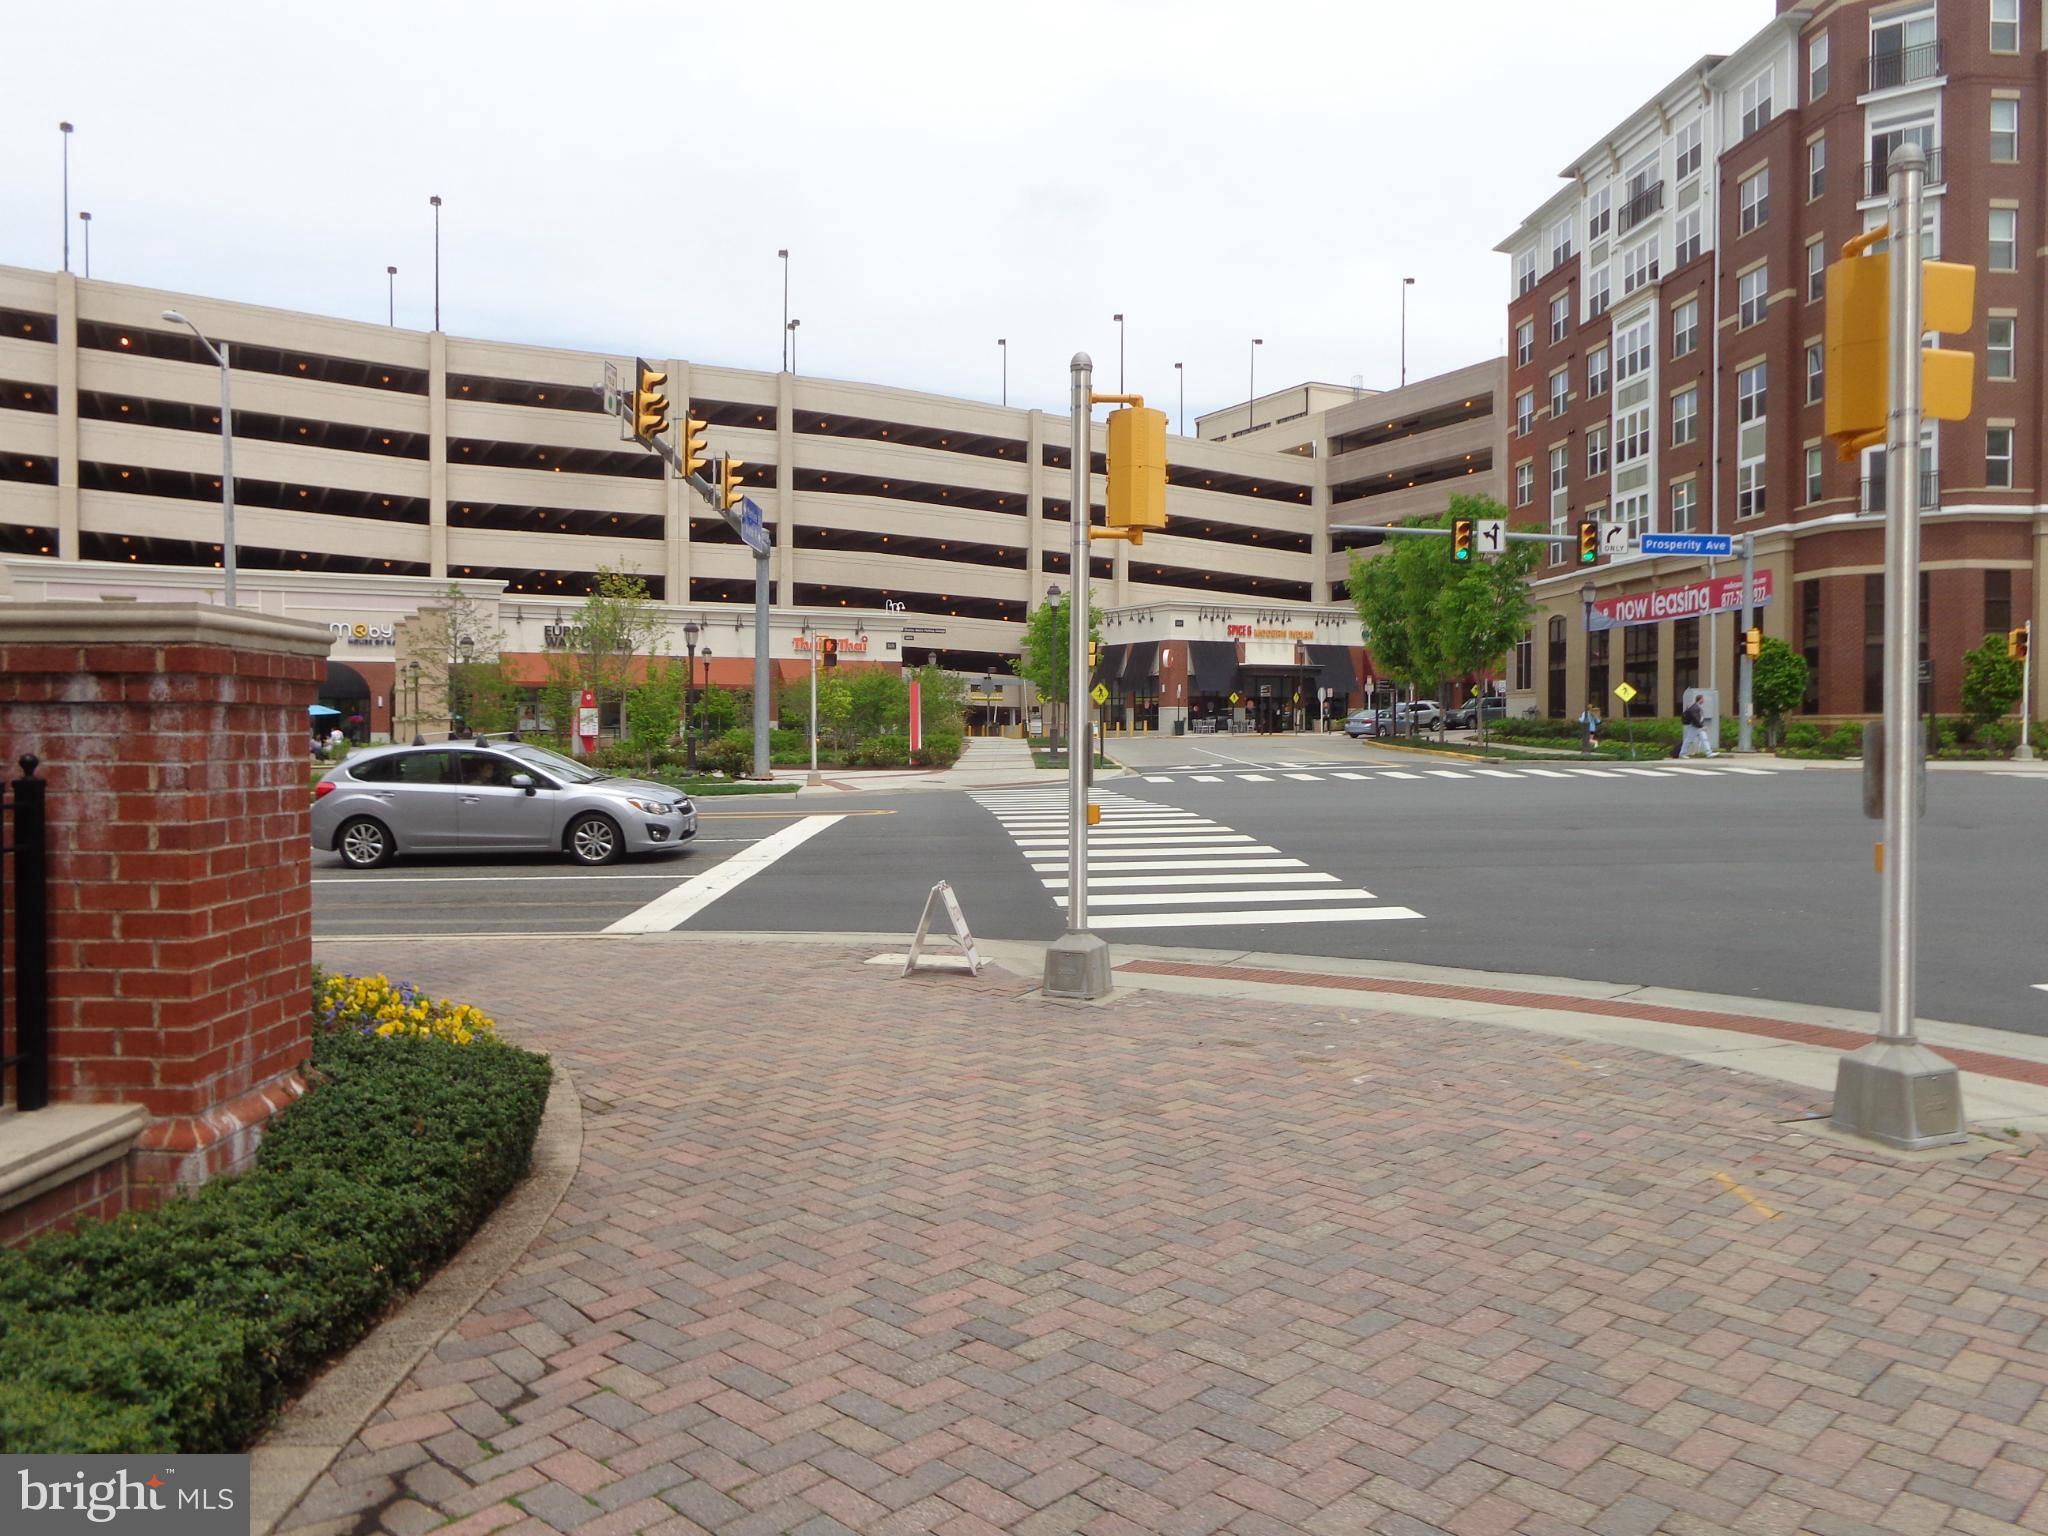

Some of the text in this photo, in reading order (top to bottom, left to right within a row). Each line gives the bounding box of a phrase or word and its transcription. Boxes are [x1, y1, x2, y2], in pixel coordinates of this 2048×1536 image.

[1646, 539, 1727, 551] Prosperity Ave
[1616, 598, 1648, 621] now
[1651, 585, 1710, 612] leasing
[330, 623, 393, 639] moby
[1227, 624, 1246, 637] SPICE
